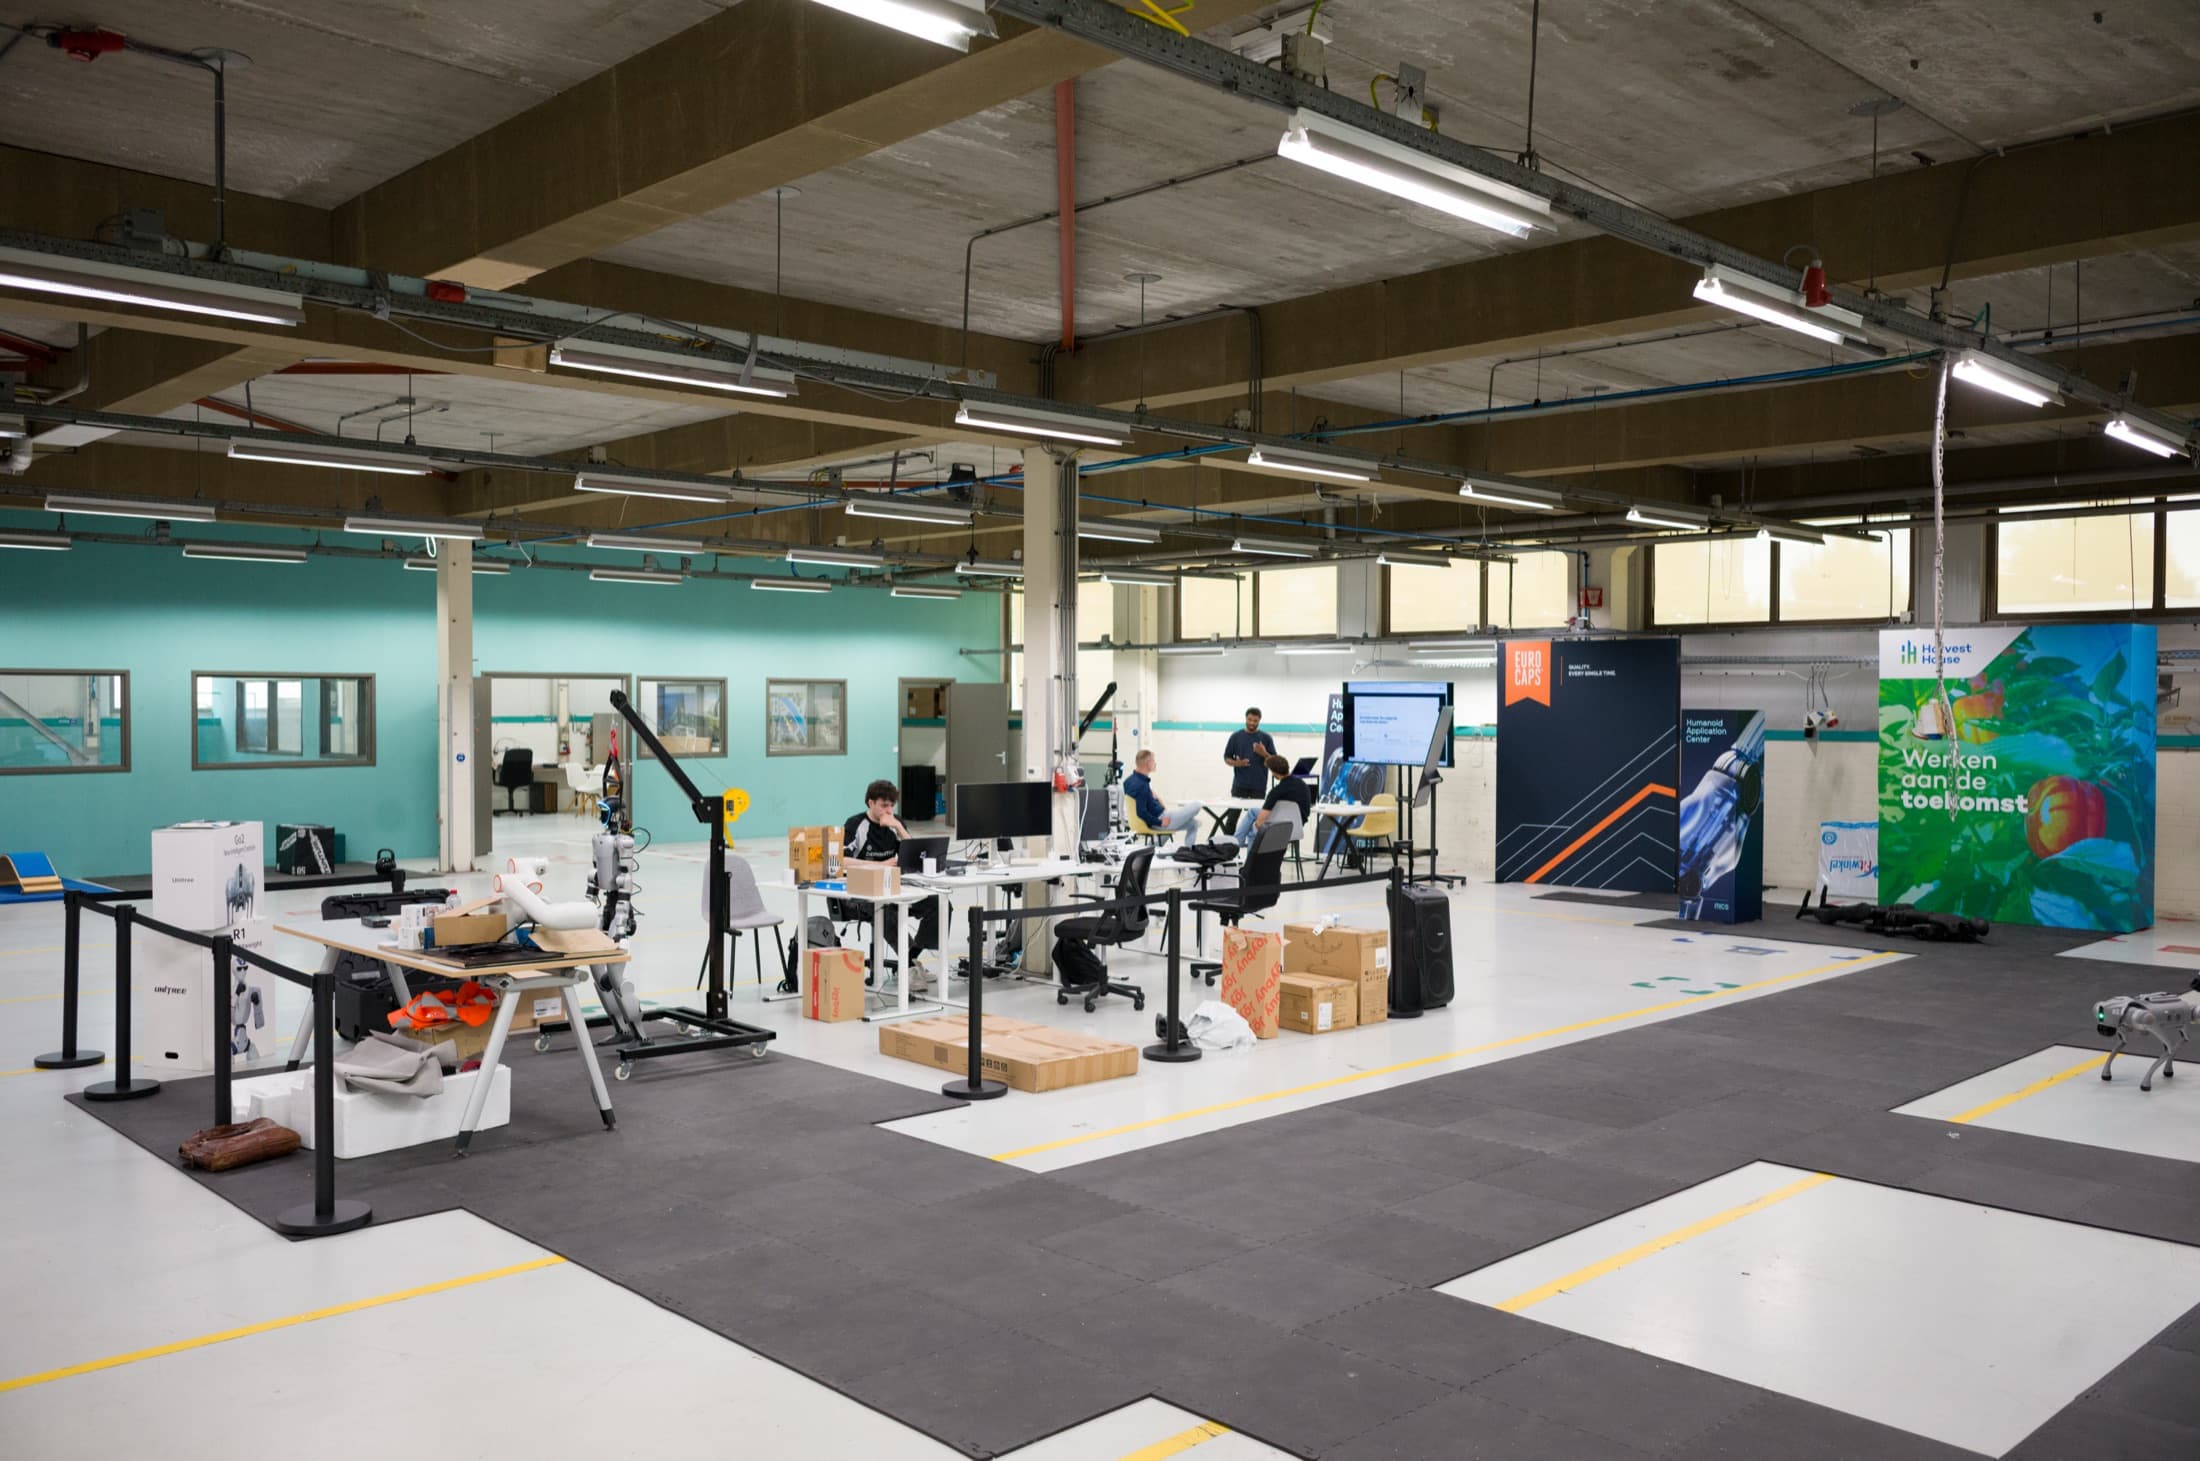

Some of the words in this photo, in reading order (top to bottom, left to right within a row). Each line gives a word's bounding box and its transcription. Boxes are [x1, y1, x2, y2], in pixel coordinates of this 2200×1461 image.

[1921, 643, 1973, 654] Havest
[1515, 650, 1542, 668] EURO
[1921, 654, 1961, 665] Hose
[1514, 668, 1542, 686] CAPS
[1686, 719, 1724, 728] Humanoid
[1686, 727, 1727, 736] Application
[1686, 735, 1711, 743] Center
[1901, 773, 1947, 789] aan
[1957, 770, 1986, 790] de
[233, 928, 246, 940] R1
